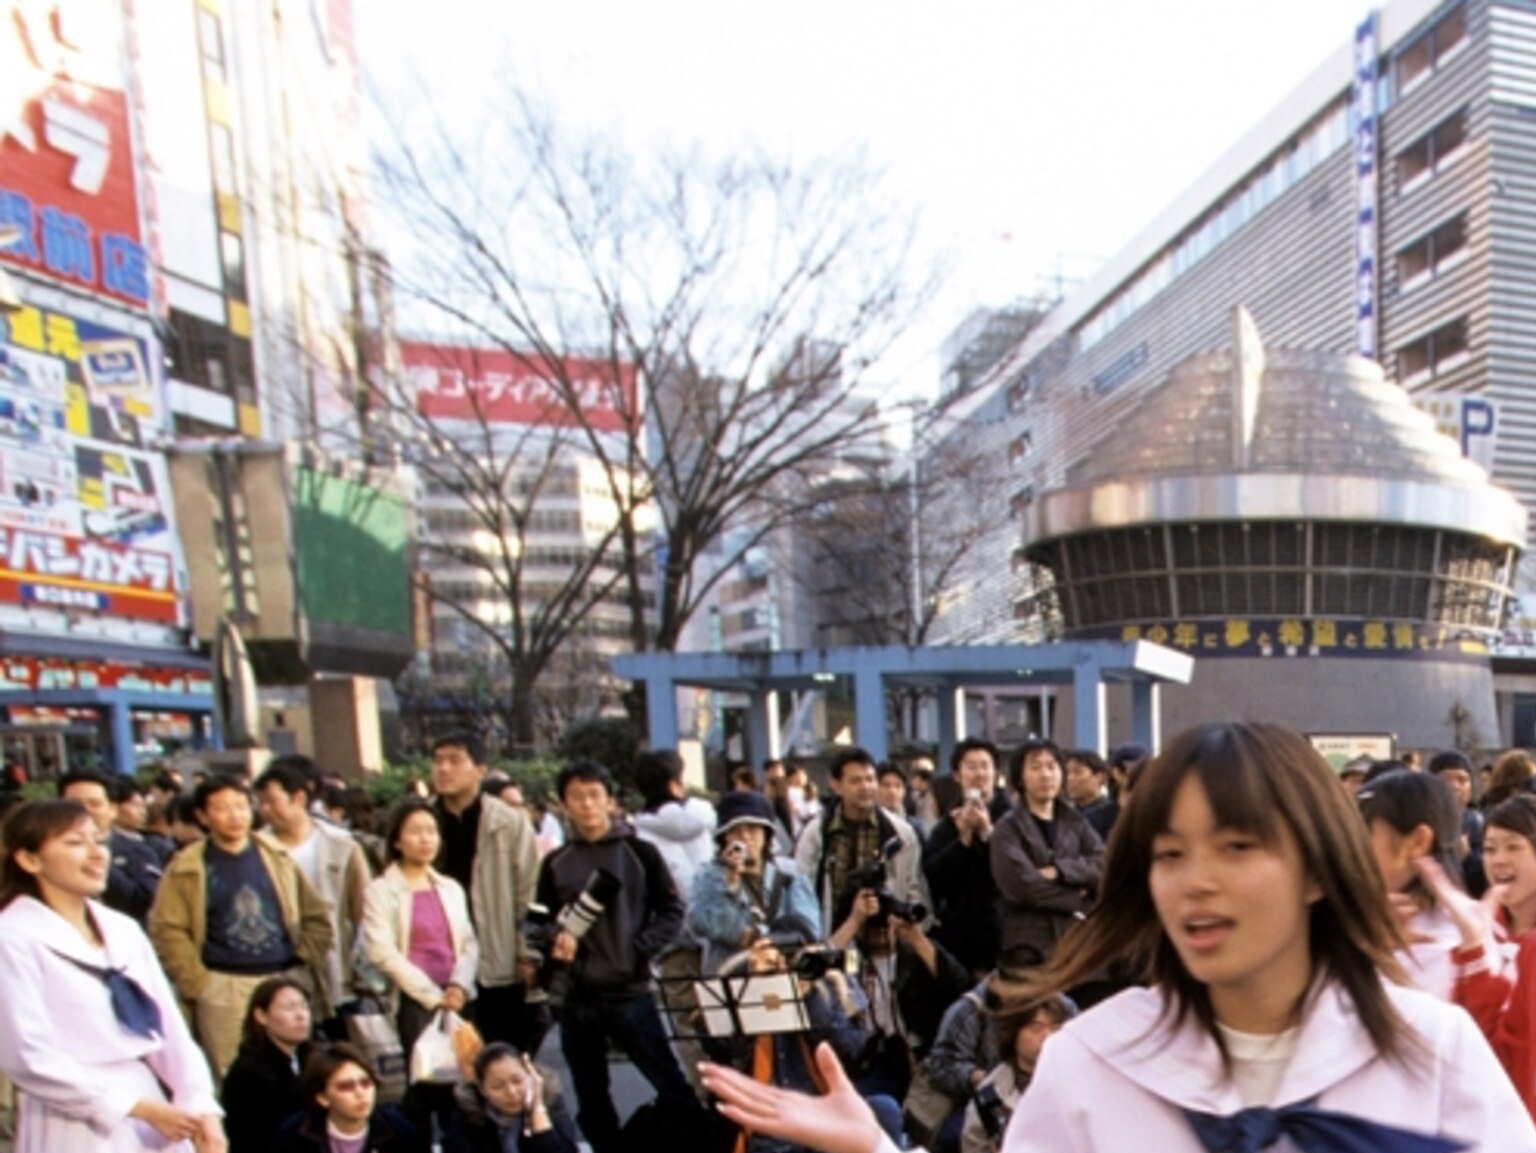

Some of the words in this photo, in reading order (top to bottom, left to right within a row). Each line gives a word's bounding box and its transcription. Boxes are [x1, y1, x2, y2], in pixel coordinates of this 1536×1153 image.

[1463, 400, 1493, 457] P
[0, 527, 169, 592] バシカメラ
